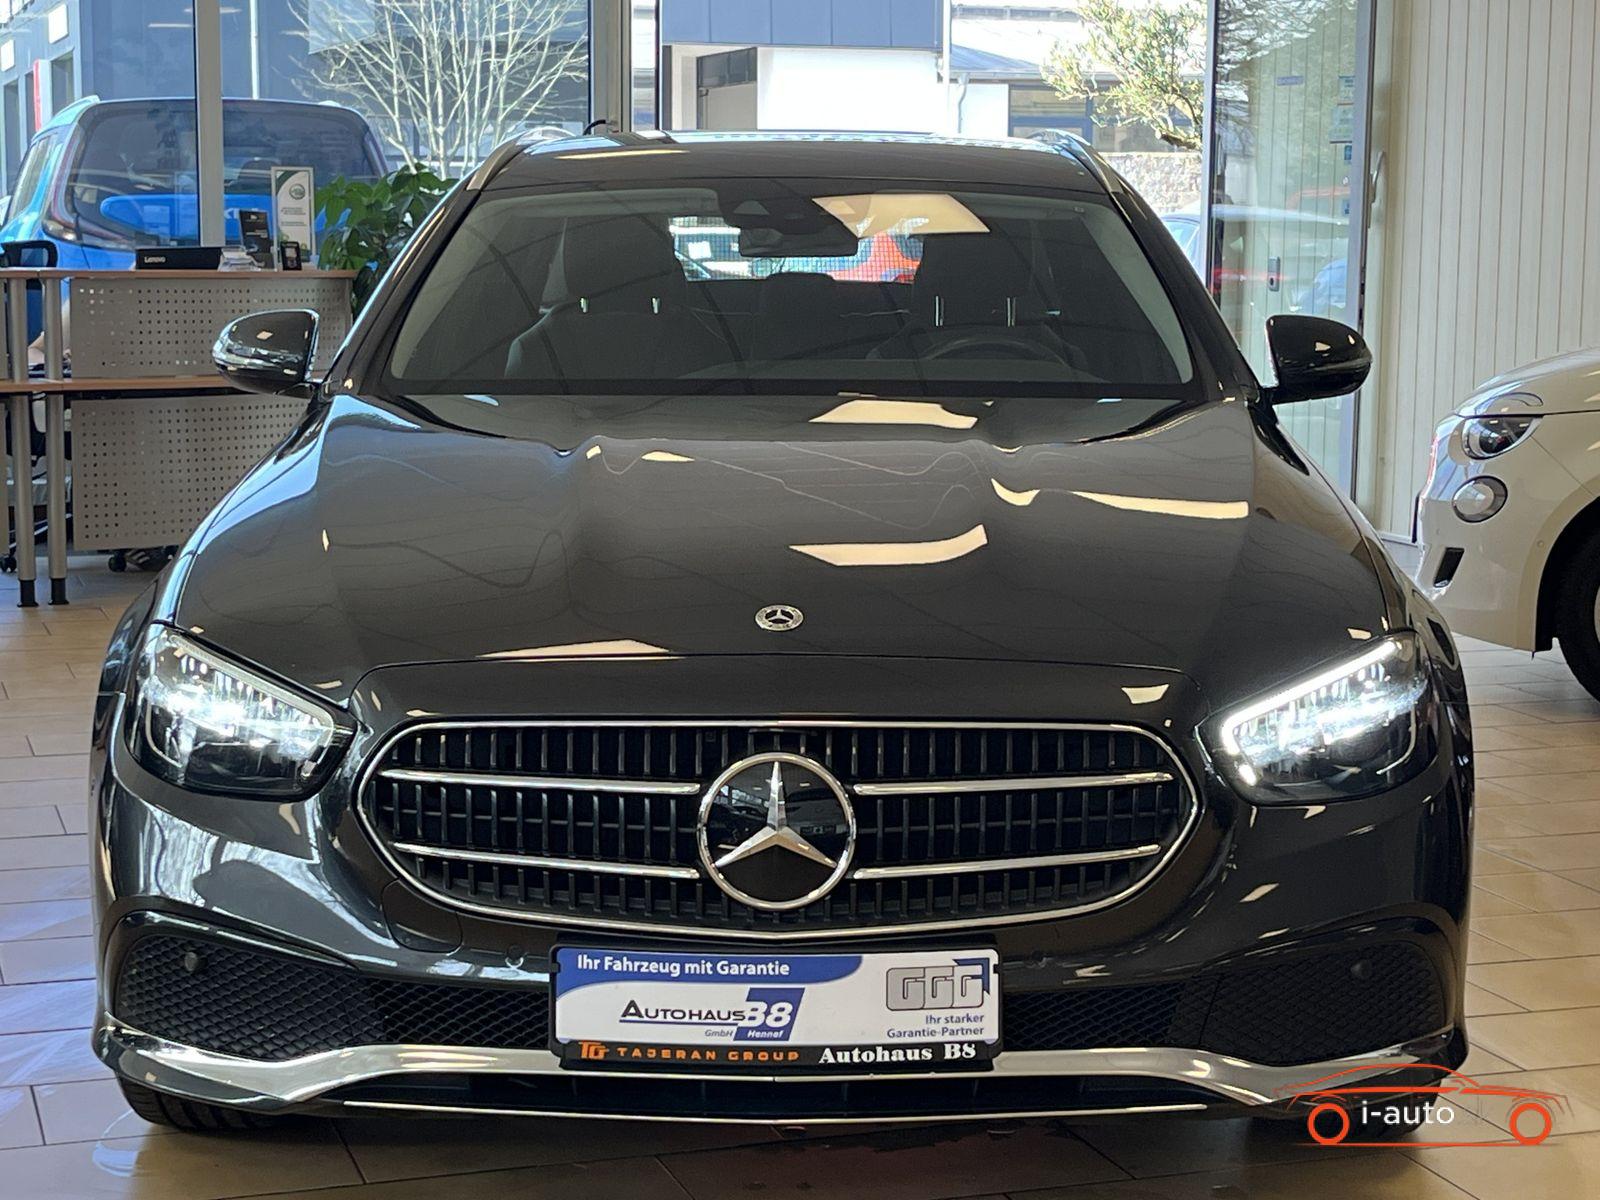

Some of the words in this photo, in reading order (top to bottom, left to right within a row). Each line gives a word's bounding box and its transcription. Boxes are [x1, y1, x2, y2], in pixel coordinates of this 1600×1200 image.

[577, 954, 600, 970] Ihr
[604, 956, 681, 977] Fahrzeug
[684, 960, 713, 976] mit
[716, 960, 790, 976] Garantie
[925, 1014, 942, 1024] Ihr
[944, 1012, 985, 1024] starker
[704, 1029, 734, 1037] GmbH
[747, 1030, 784, 1038] Hennef
[887, 1026, 985, 1039] Garantie-Partner
[617, 1047, 716, 1061] TAJERAN
[727, 1051, 799, 1061] GROUP
[818, 1045, 933, 1064] Autohaus
